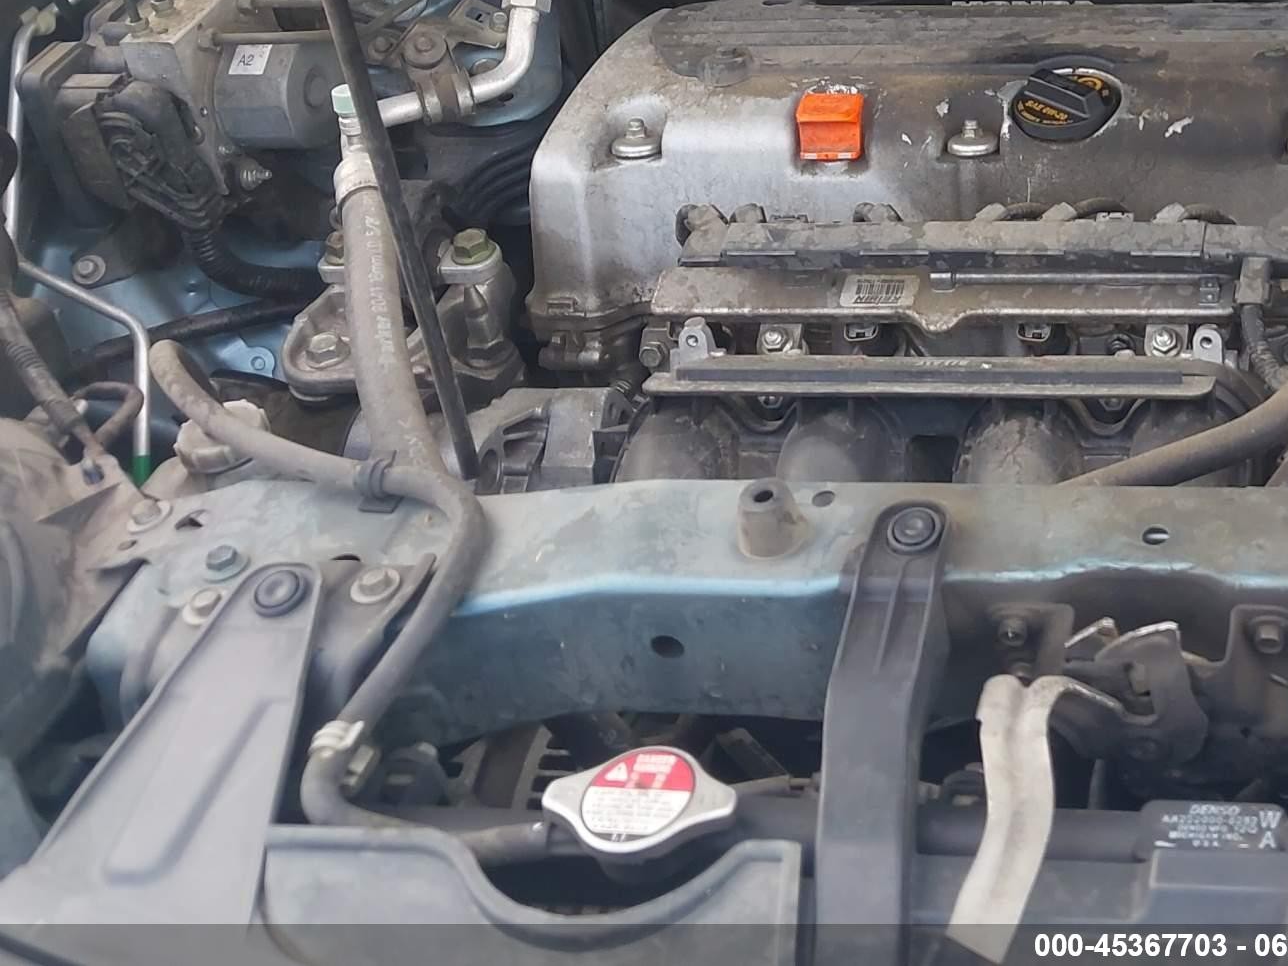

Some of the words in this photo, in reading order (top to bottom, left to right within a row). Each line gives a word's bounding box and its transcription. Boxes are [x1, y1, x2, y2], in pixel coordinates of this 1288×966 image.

[238, 54, 255, 66] A2
[1189, 804, 1240, 815] DENSO
[1259, 811, 1281, 829] W
[1258, 831, 1277, 849] A
